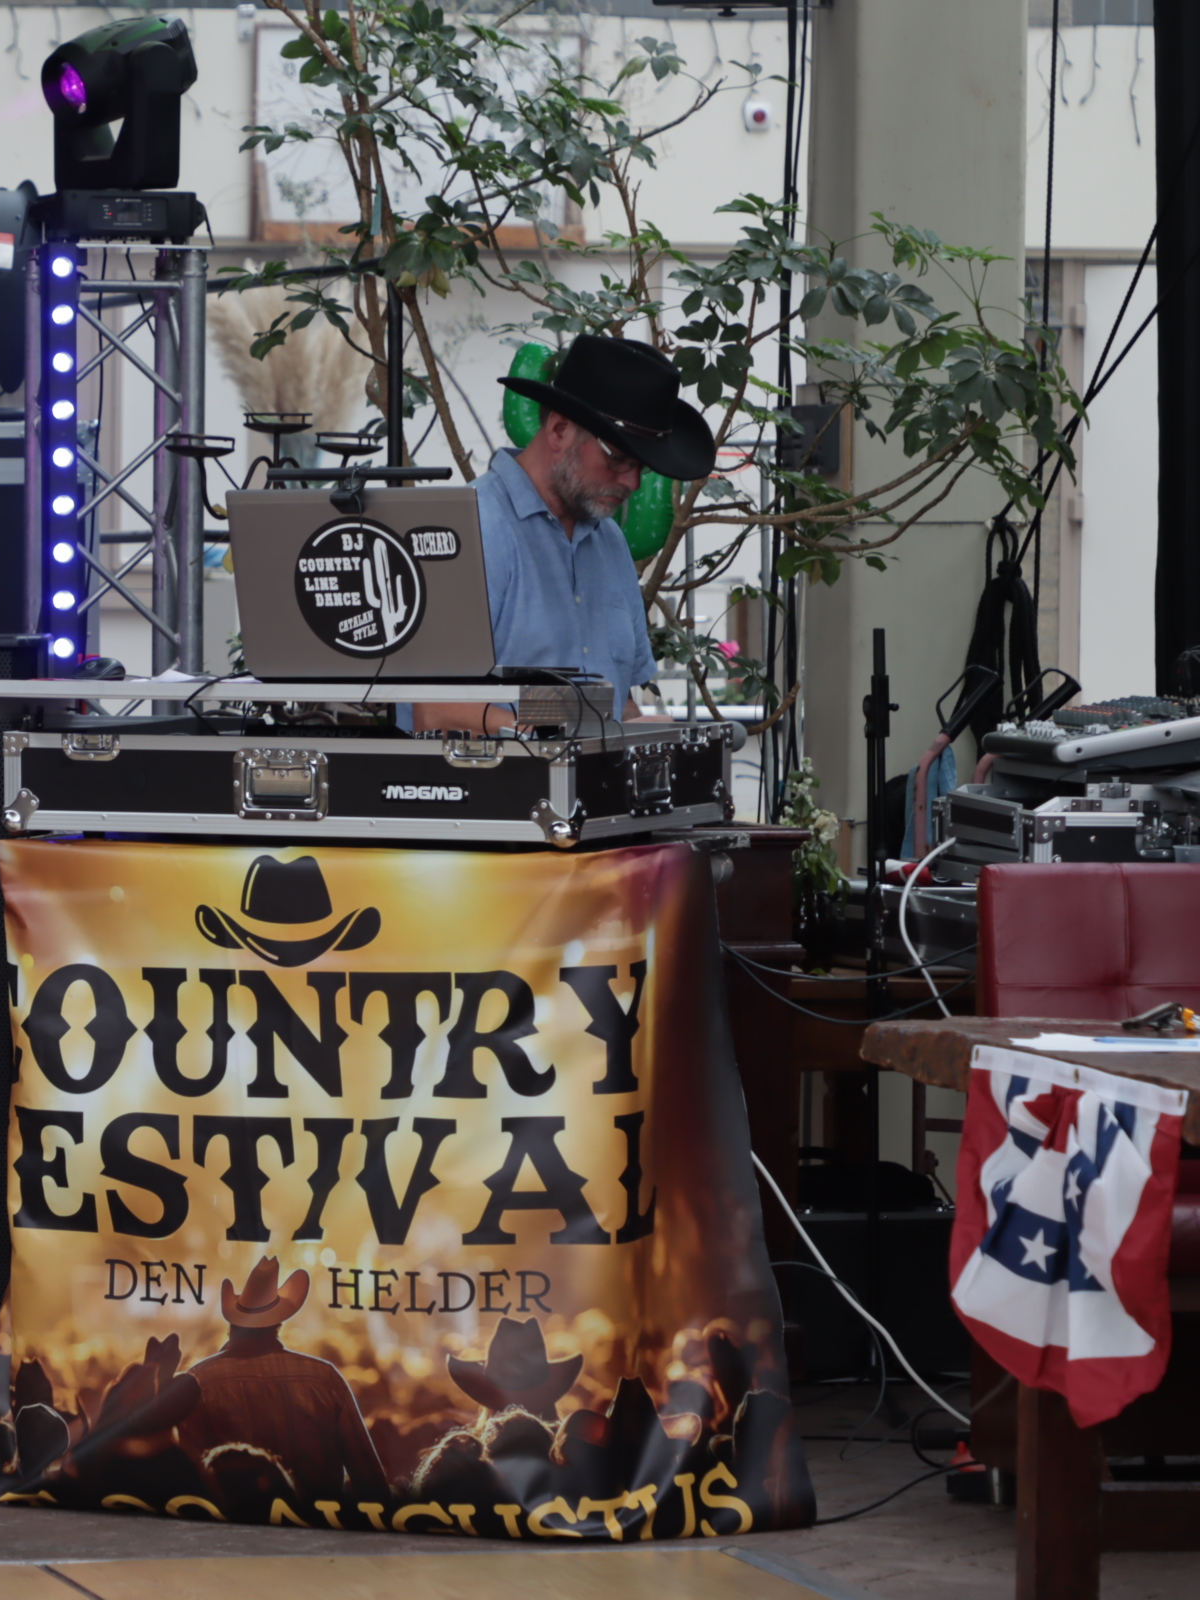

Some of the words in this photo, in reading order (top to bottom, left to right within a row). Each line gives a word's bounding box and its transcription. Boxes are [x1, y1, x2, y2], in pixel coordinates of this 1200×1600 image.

[341, 533, 363, 551] DJ
[411, 531, 456, 556] RICHARD
[299, 556, 361, 572] COUNTRY
[304, 576, 339, 591] LINE
[315, 592, 361, 607] DANCE
[338, 609, 374, 633] CATALAN
[353, 622, 378, 642] STYLE
[7, 958, 648, 1100] OUNTRY
[12, 1105, 656, 1246] ESTIVAL
[103, 1258, 207, 1306] DEN
[328, 1267, 552, 1314] HELDER
